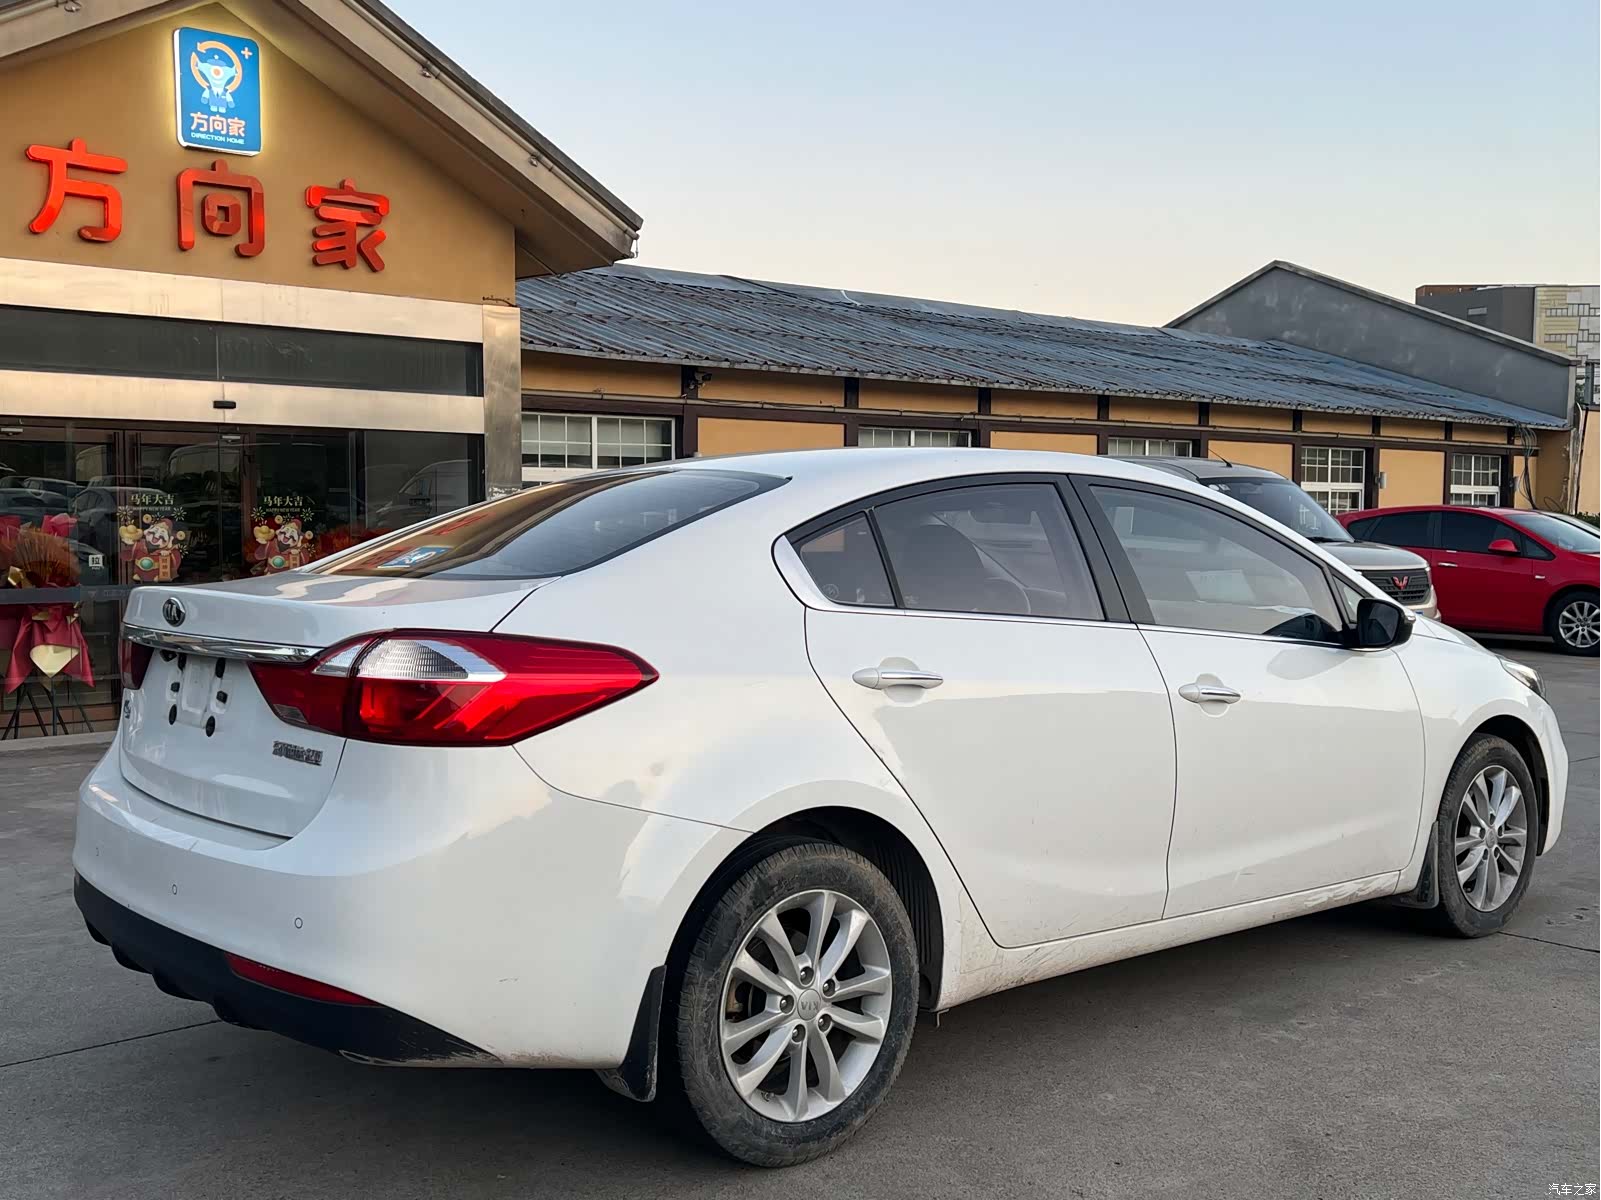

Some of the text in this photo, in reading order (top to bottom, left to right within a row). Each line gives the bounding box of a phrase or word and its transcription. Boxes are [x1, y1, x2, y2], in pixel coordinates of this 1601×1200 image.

[190, 111, 246, 137] 方向家
[191, 132, 245, 145] DIRECTION HOME
[26, 137, 391, 272] 方向家
[130, 493, 175, 505] 马年大吉
[263, 495, 304, 507] 马年大吉
[91, 556, 101, 565] 拉
